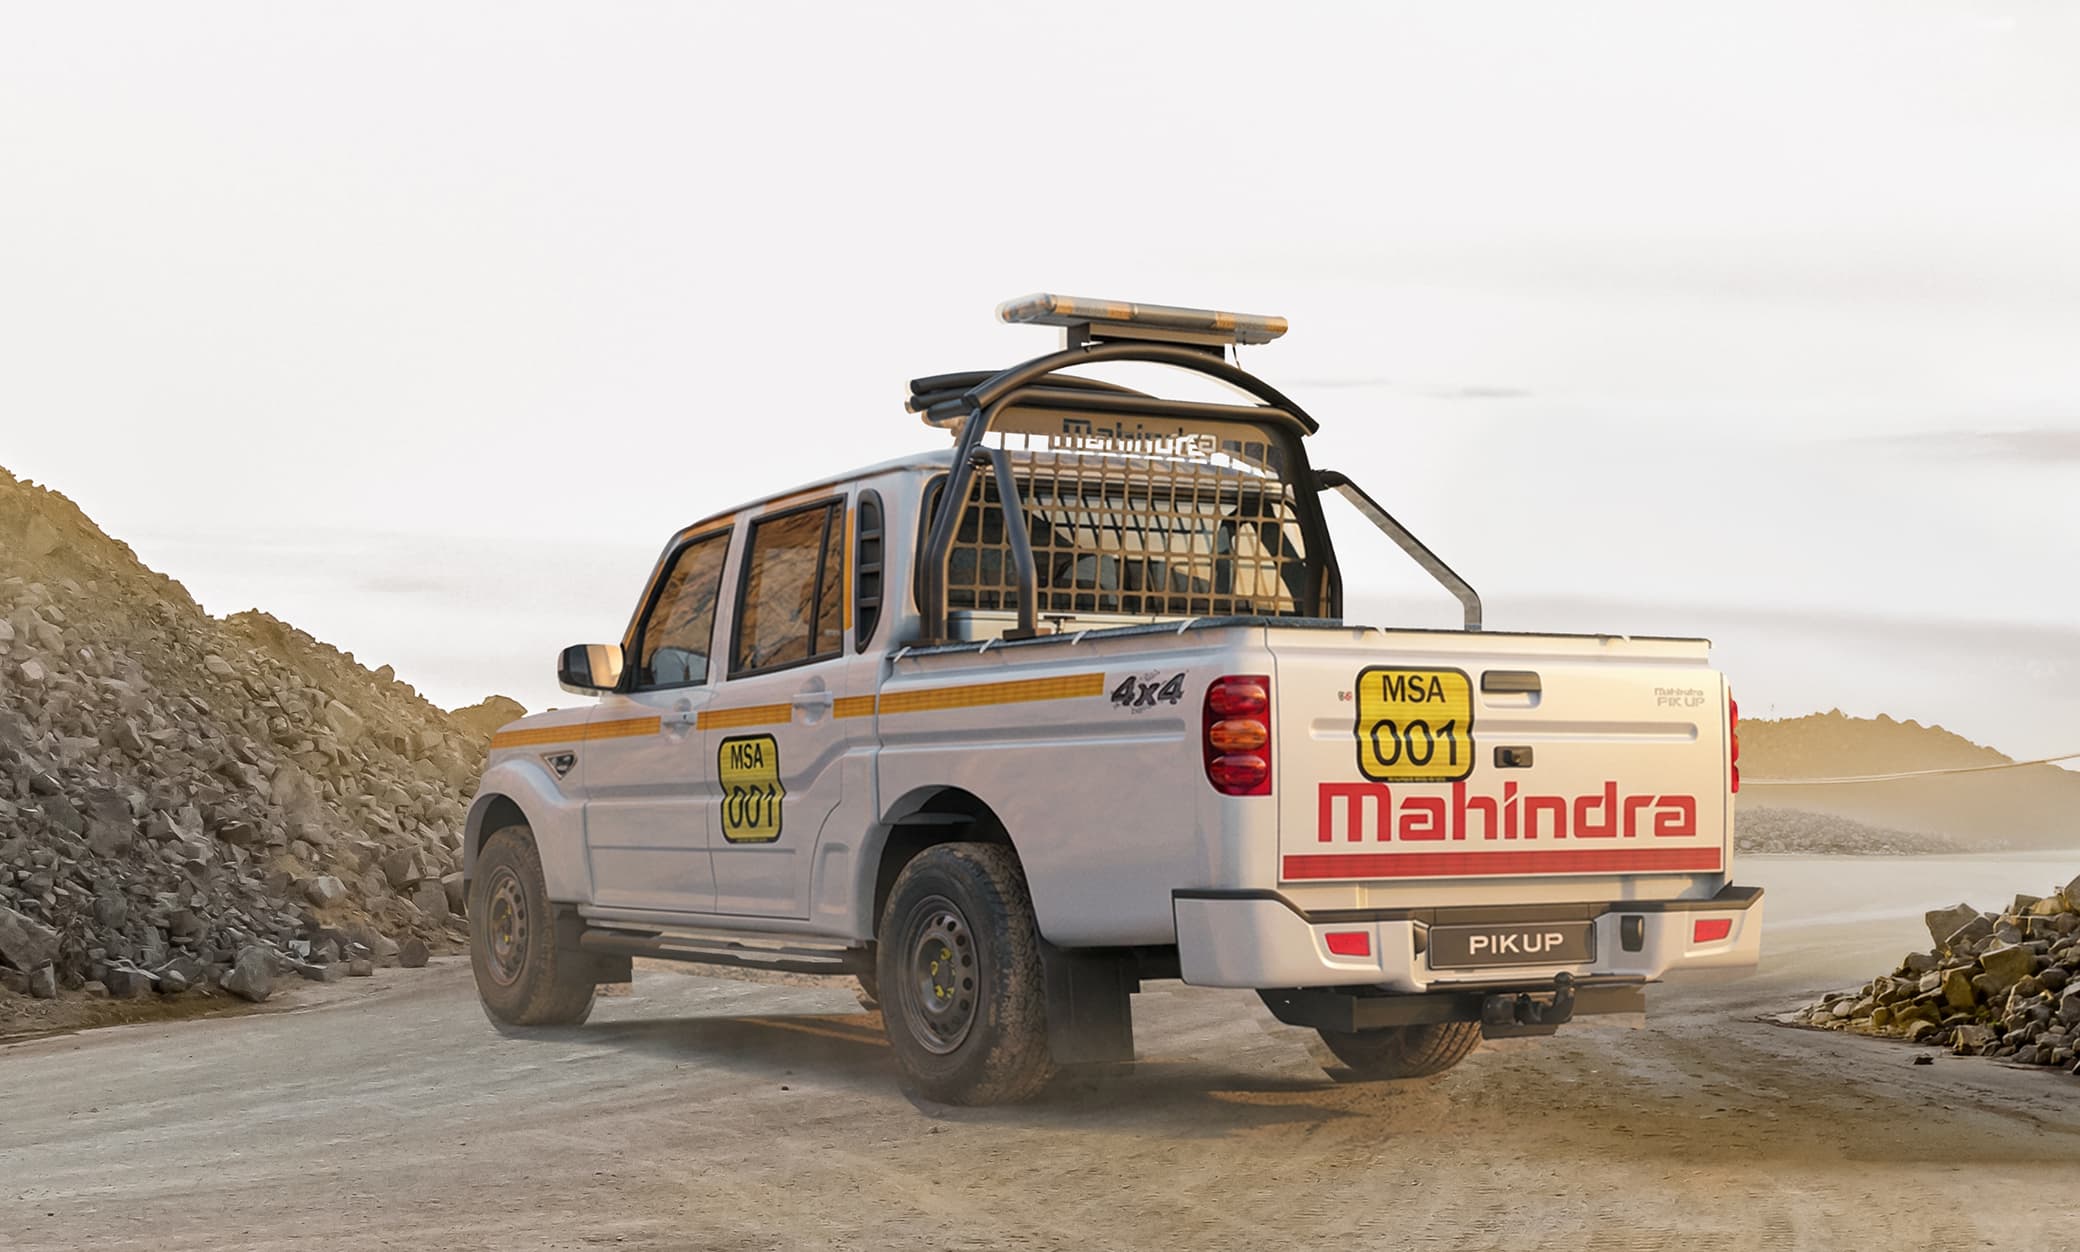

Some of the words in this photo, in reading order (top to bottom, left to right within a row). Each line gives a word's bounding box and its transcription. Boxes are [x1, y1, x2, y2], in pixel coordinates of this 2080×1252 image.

[1111, 672, 1185, 706] 4x4
[1382, 674, 1446, 703] MSA
[730, 743, 764, 769] MSA
[1370, 719, 1457, 766] 001
[728, 783, 776, 828] 001
